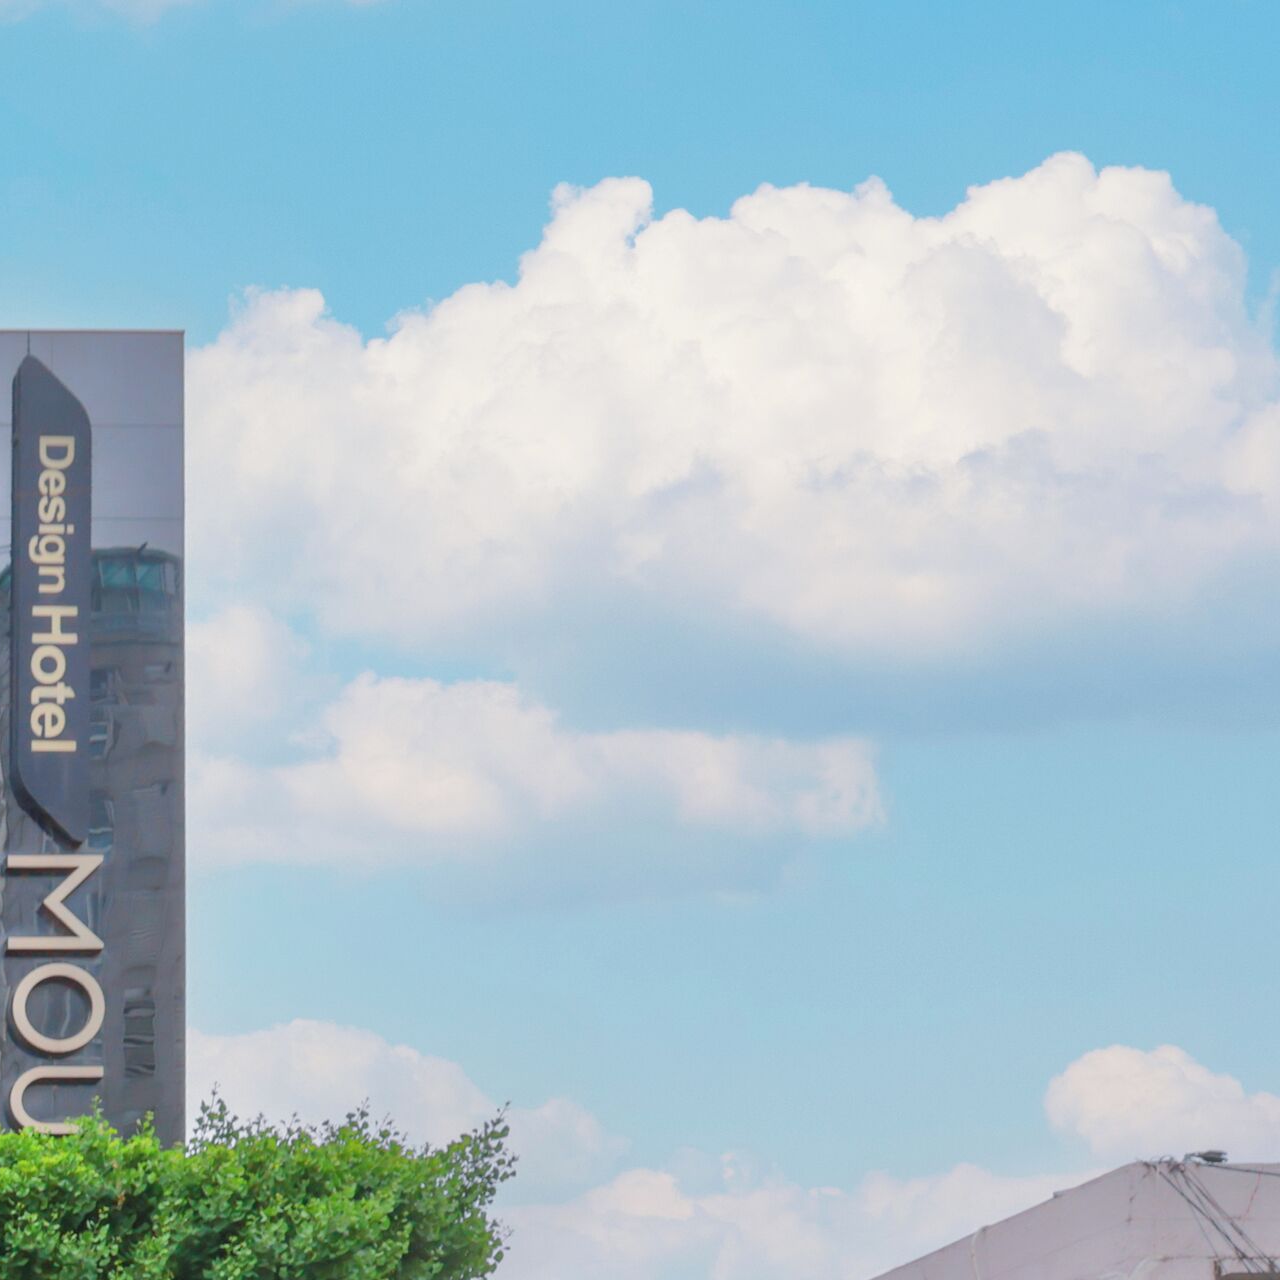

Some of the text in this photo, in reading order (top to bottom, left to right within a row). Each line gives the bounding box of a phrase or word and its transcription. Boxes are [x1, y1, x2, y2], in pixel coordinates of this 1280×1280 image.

[28, 436, 78, 752] Design Hotel
[10, 854, 105, 1135] MOU
